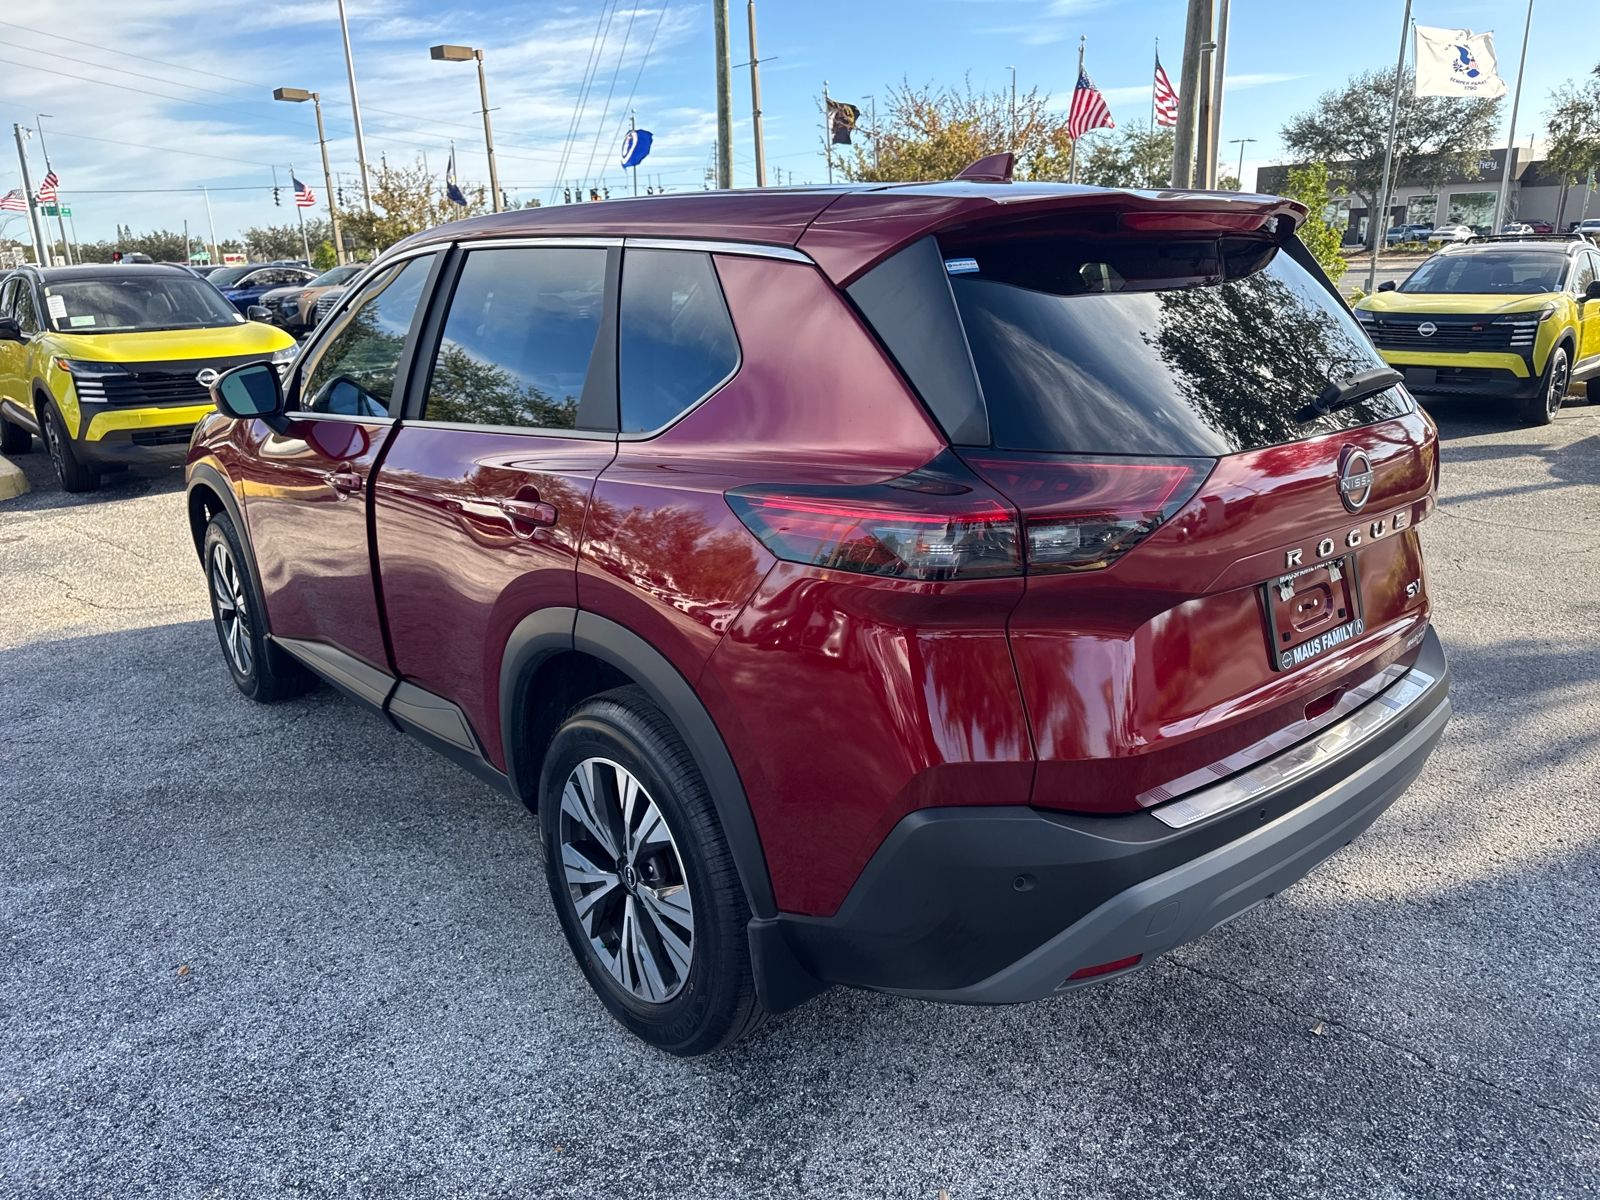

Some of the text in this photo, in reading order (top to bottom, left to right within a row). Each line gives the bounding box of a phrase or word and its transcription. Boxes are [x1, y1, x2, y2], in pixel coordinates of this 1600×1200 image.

[1285, 511, 1406, 569] ROGUE
[1405, 578, 1420, 599] SV
[1293, 622, 1354, 664] MAUS FAMILY
